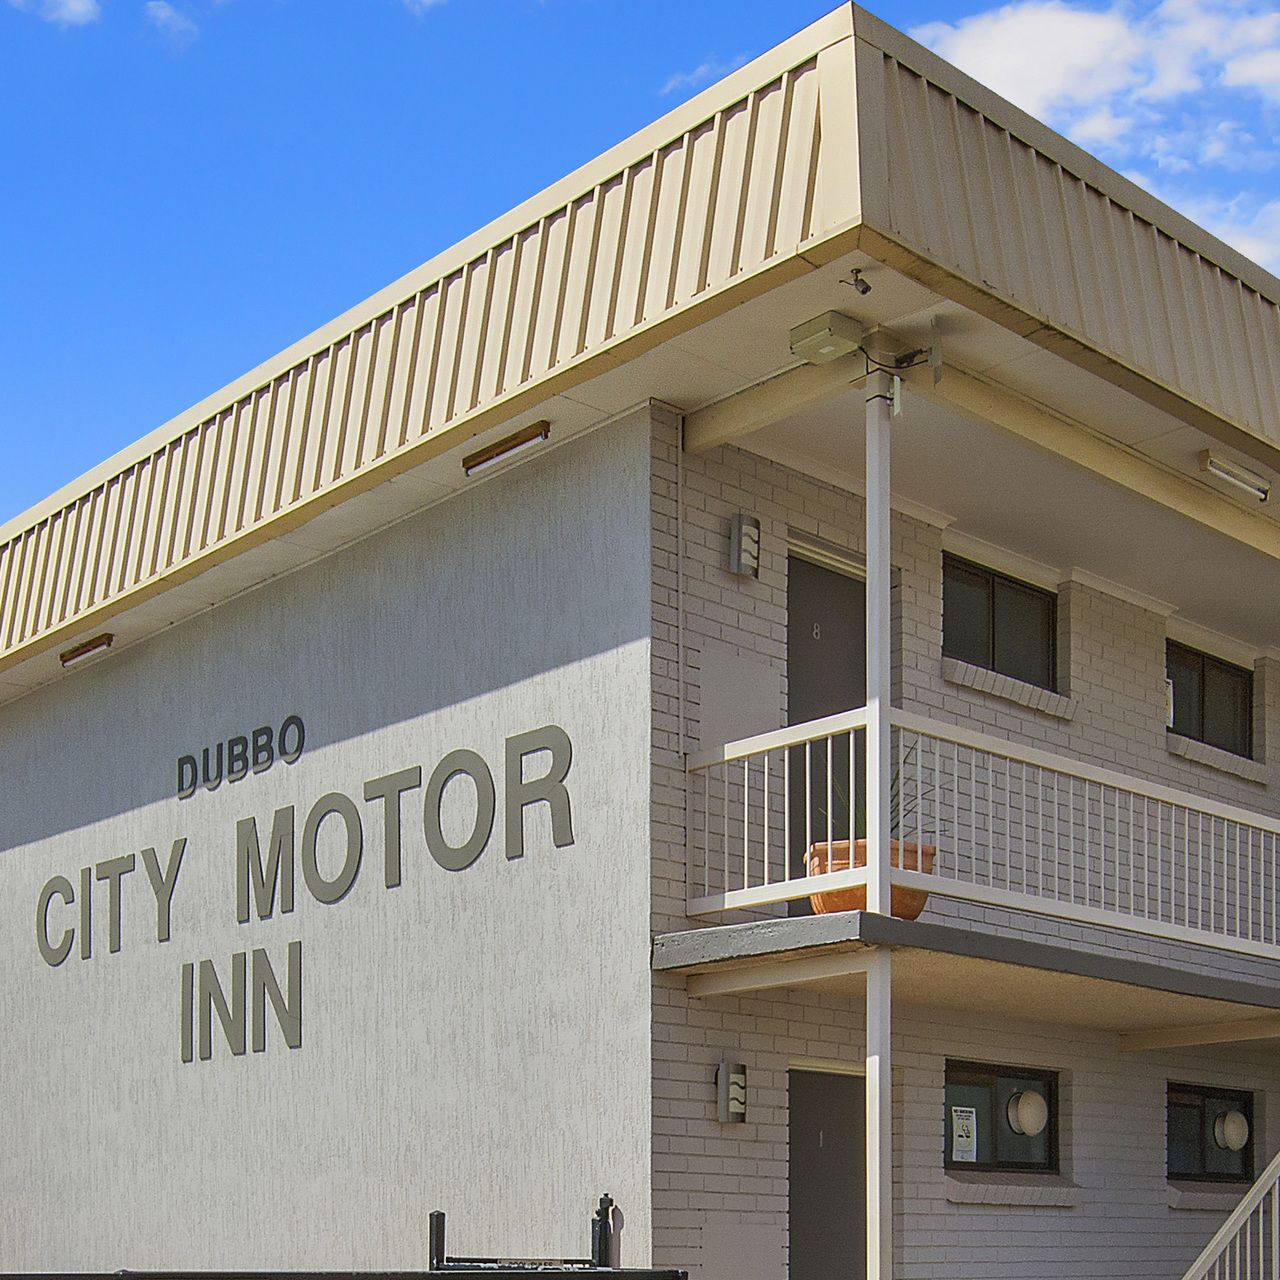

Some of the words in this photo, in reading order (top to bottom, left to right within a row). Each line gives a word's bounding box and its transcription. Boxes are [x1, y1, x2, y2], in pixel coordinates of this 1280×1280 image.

[813, 622, 820, 640] 8
[177, 715, 305, 800] DUBBO
[35, 837, 187, 966] CITY
[236, 725, 574, 924] MOTOR
[181, 940, 302, 1063] INN
